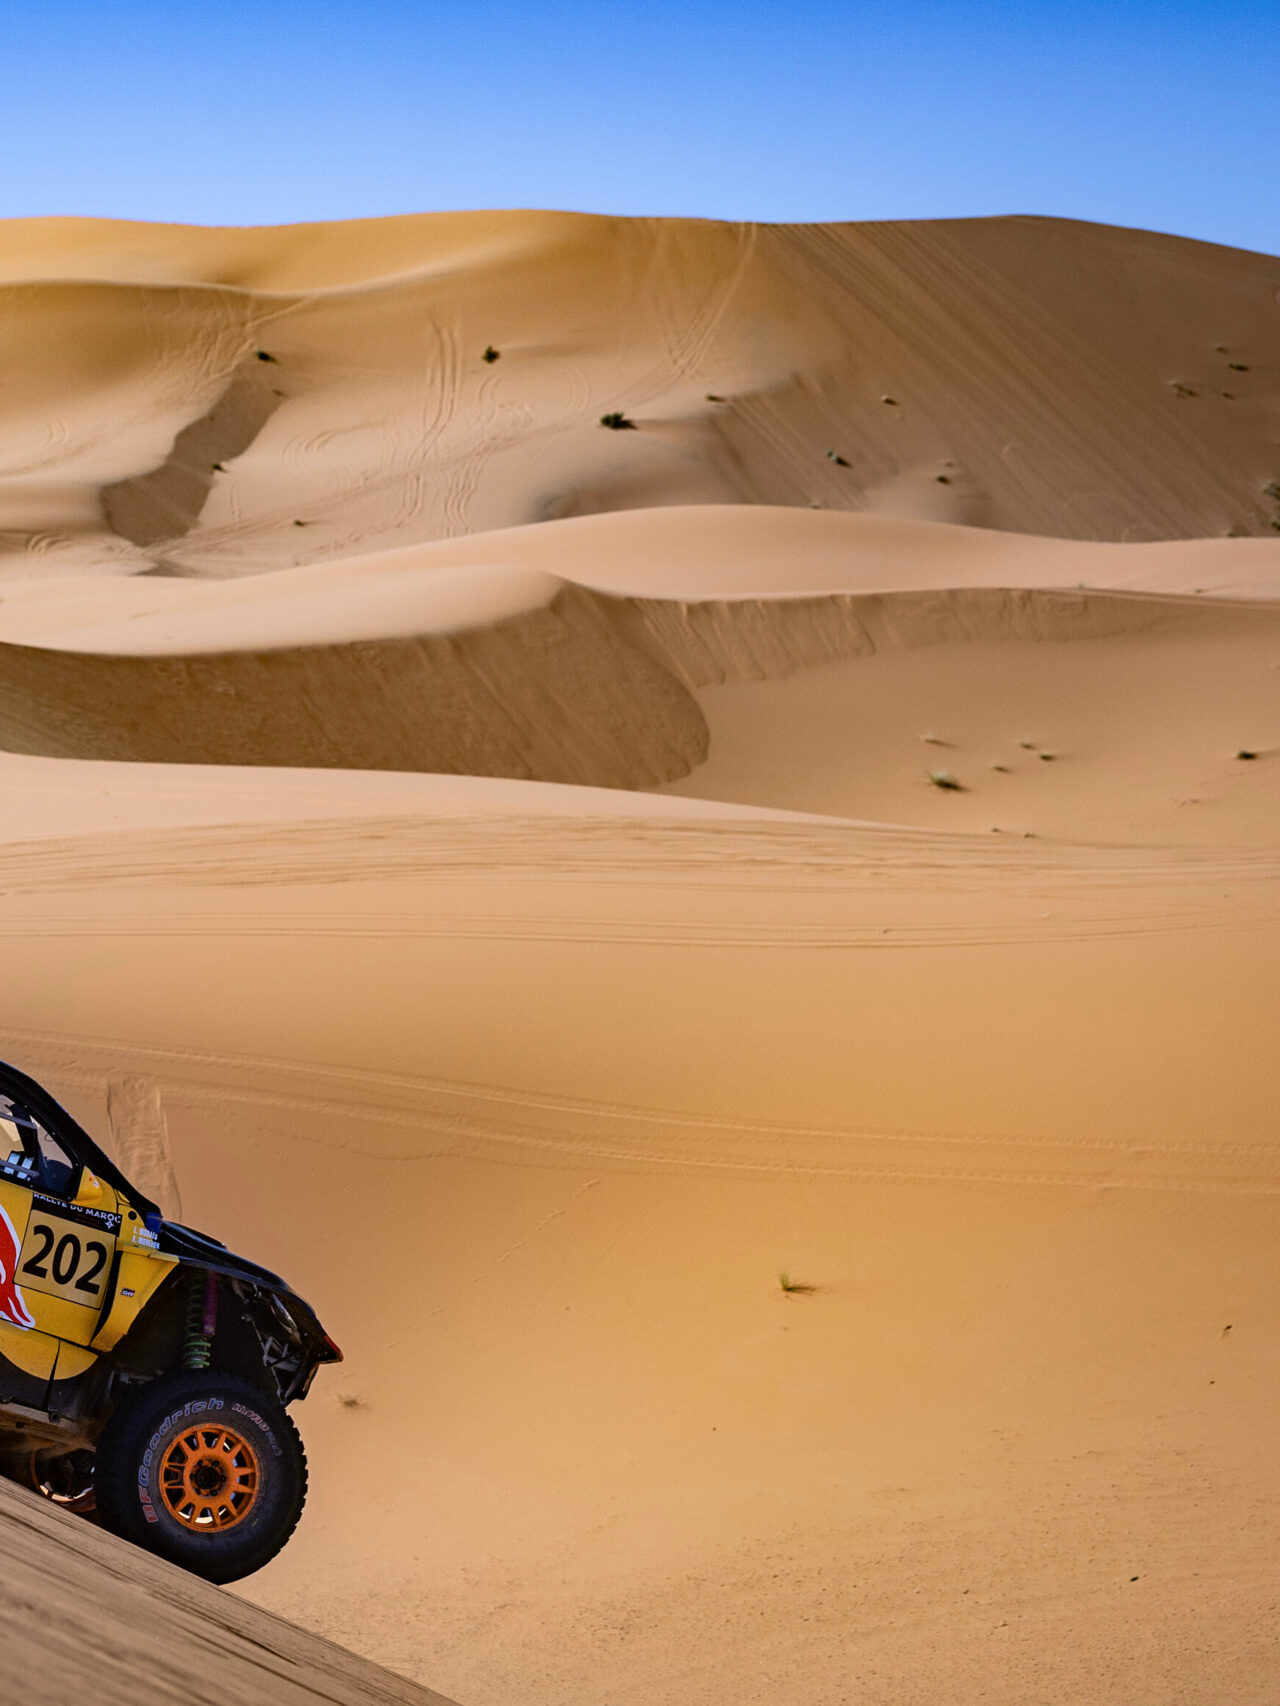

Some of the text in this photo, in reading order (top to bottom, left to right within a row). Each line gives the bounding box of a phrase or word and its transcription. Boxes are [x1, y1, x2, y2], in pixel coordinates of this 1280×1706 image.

[85, 1207, 121, 1224] MAROC
[22, 1224, 108, 1296] 202
[138, 1397, 225, 1523] BFGoodrich
